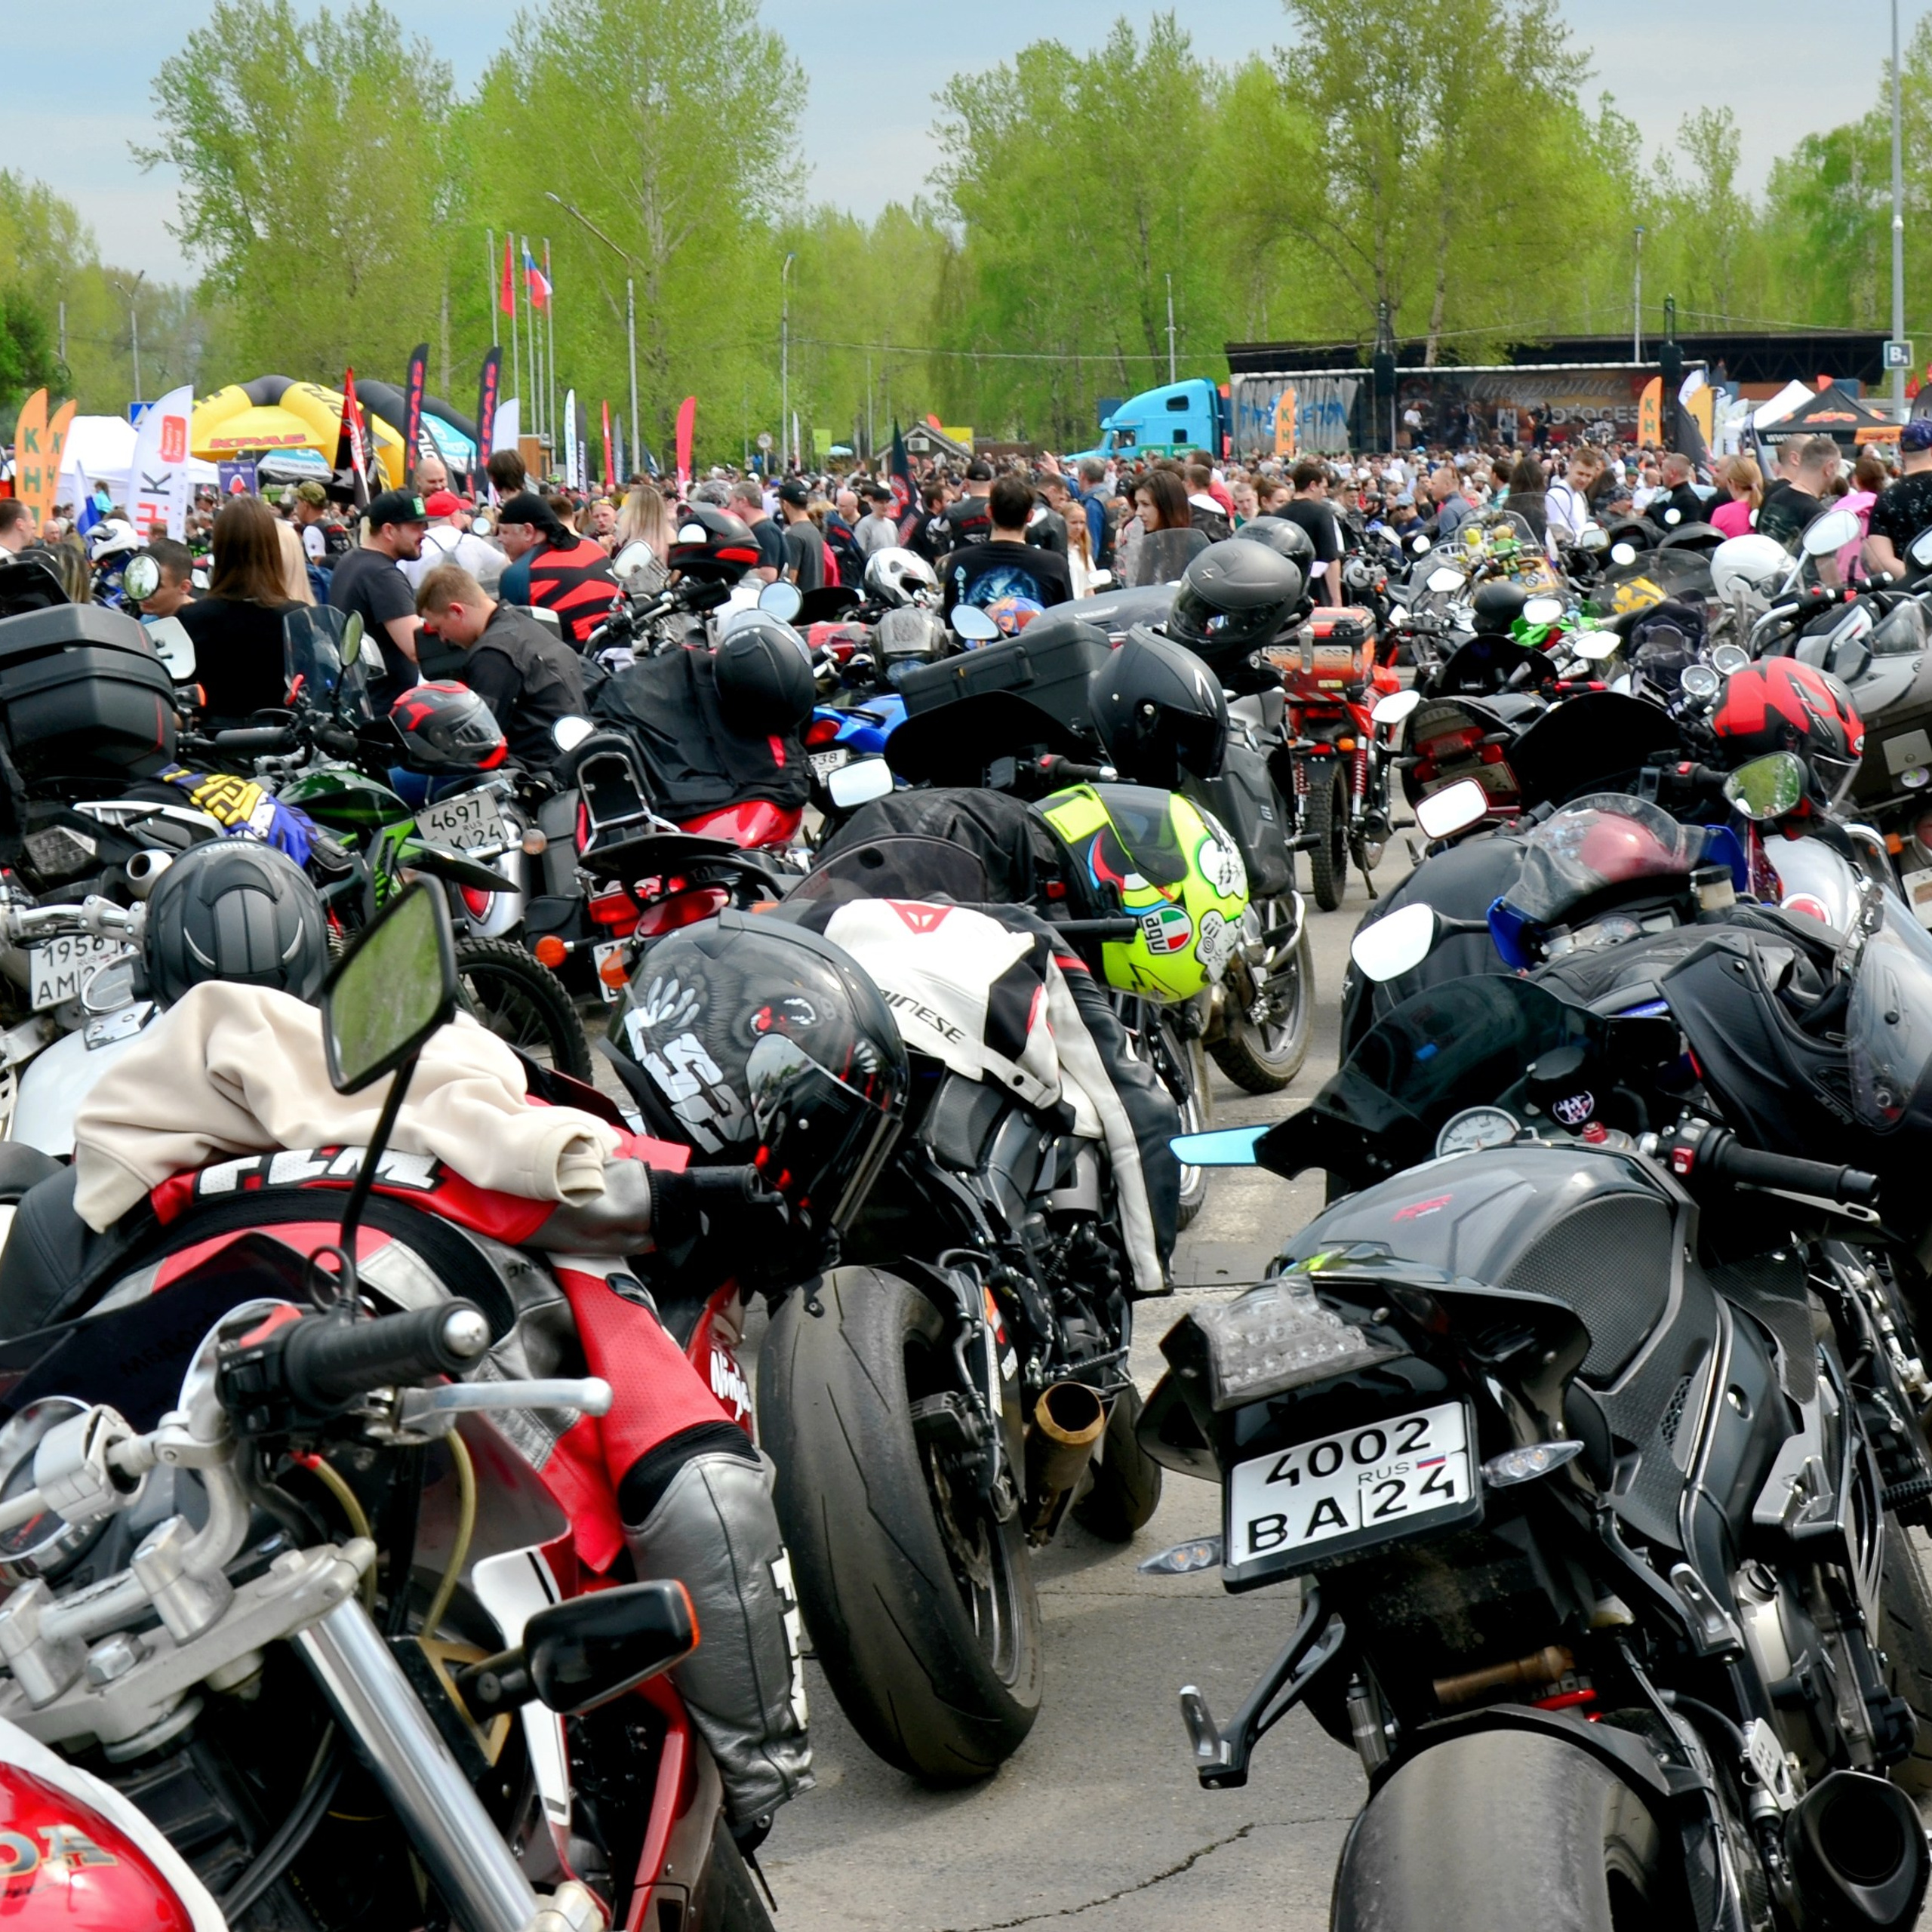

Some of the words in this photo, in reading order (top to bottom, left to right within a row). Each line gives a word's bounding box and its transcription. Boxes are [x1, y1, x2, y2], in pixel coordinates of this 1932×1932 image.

[431, 799, 480, 830] 4697
[462, 820, 483, 832] RUS
[78, 954, 97, 967] RUS
[710, 1350, 752, 1422] Ninja
[1265, 1417, 1431, 1487] 4002
[1358, 1462, 1410, 1485] RUS
[1248, 1497, 1349, 1553] BA
[1372, 1464, 1455, 1518] 24
